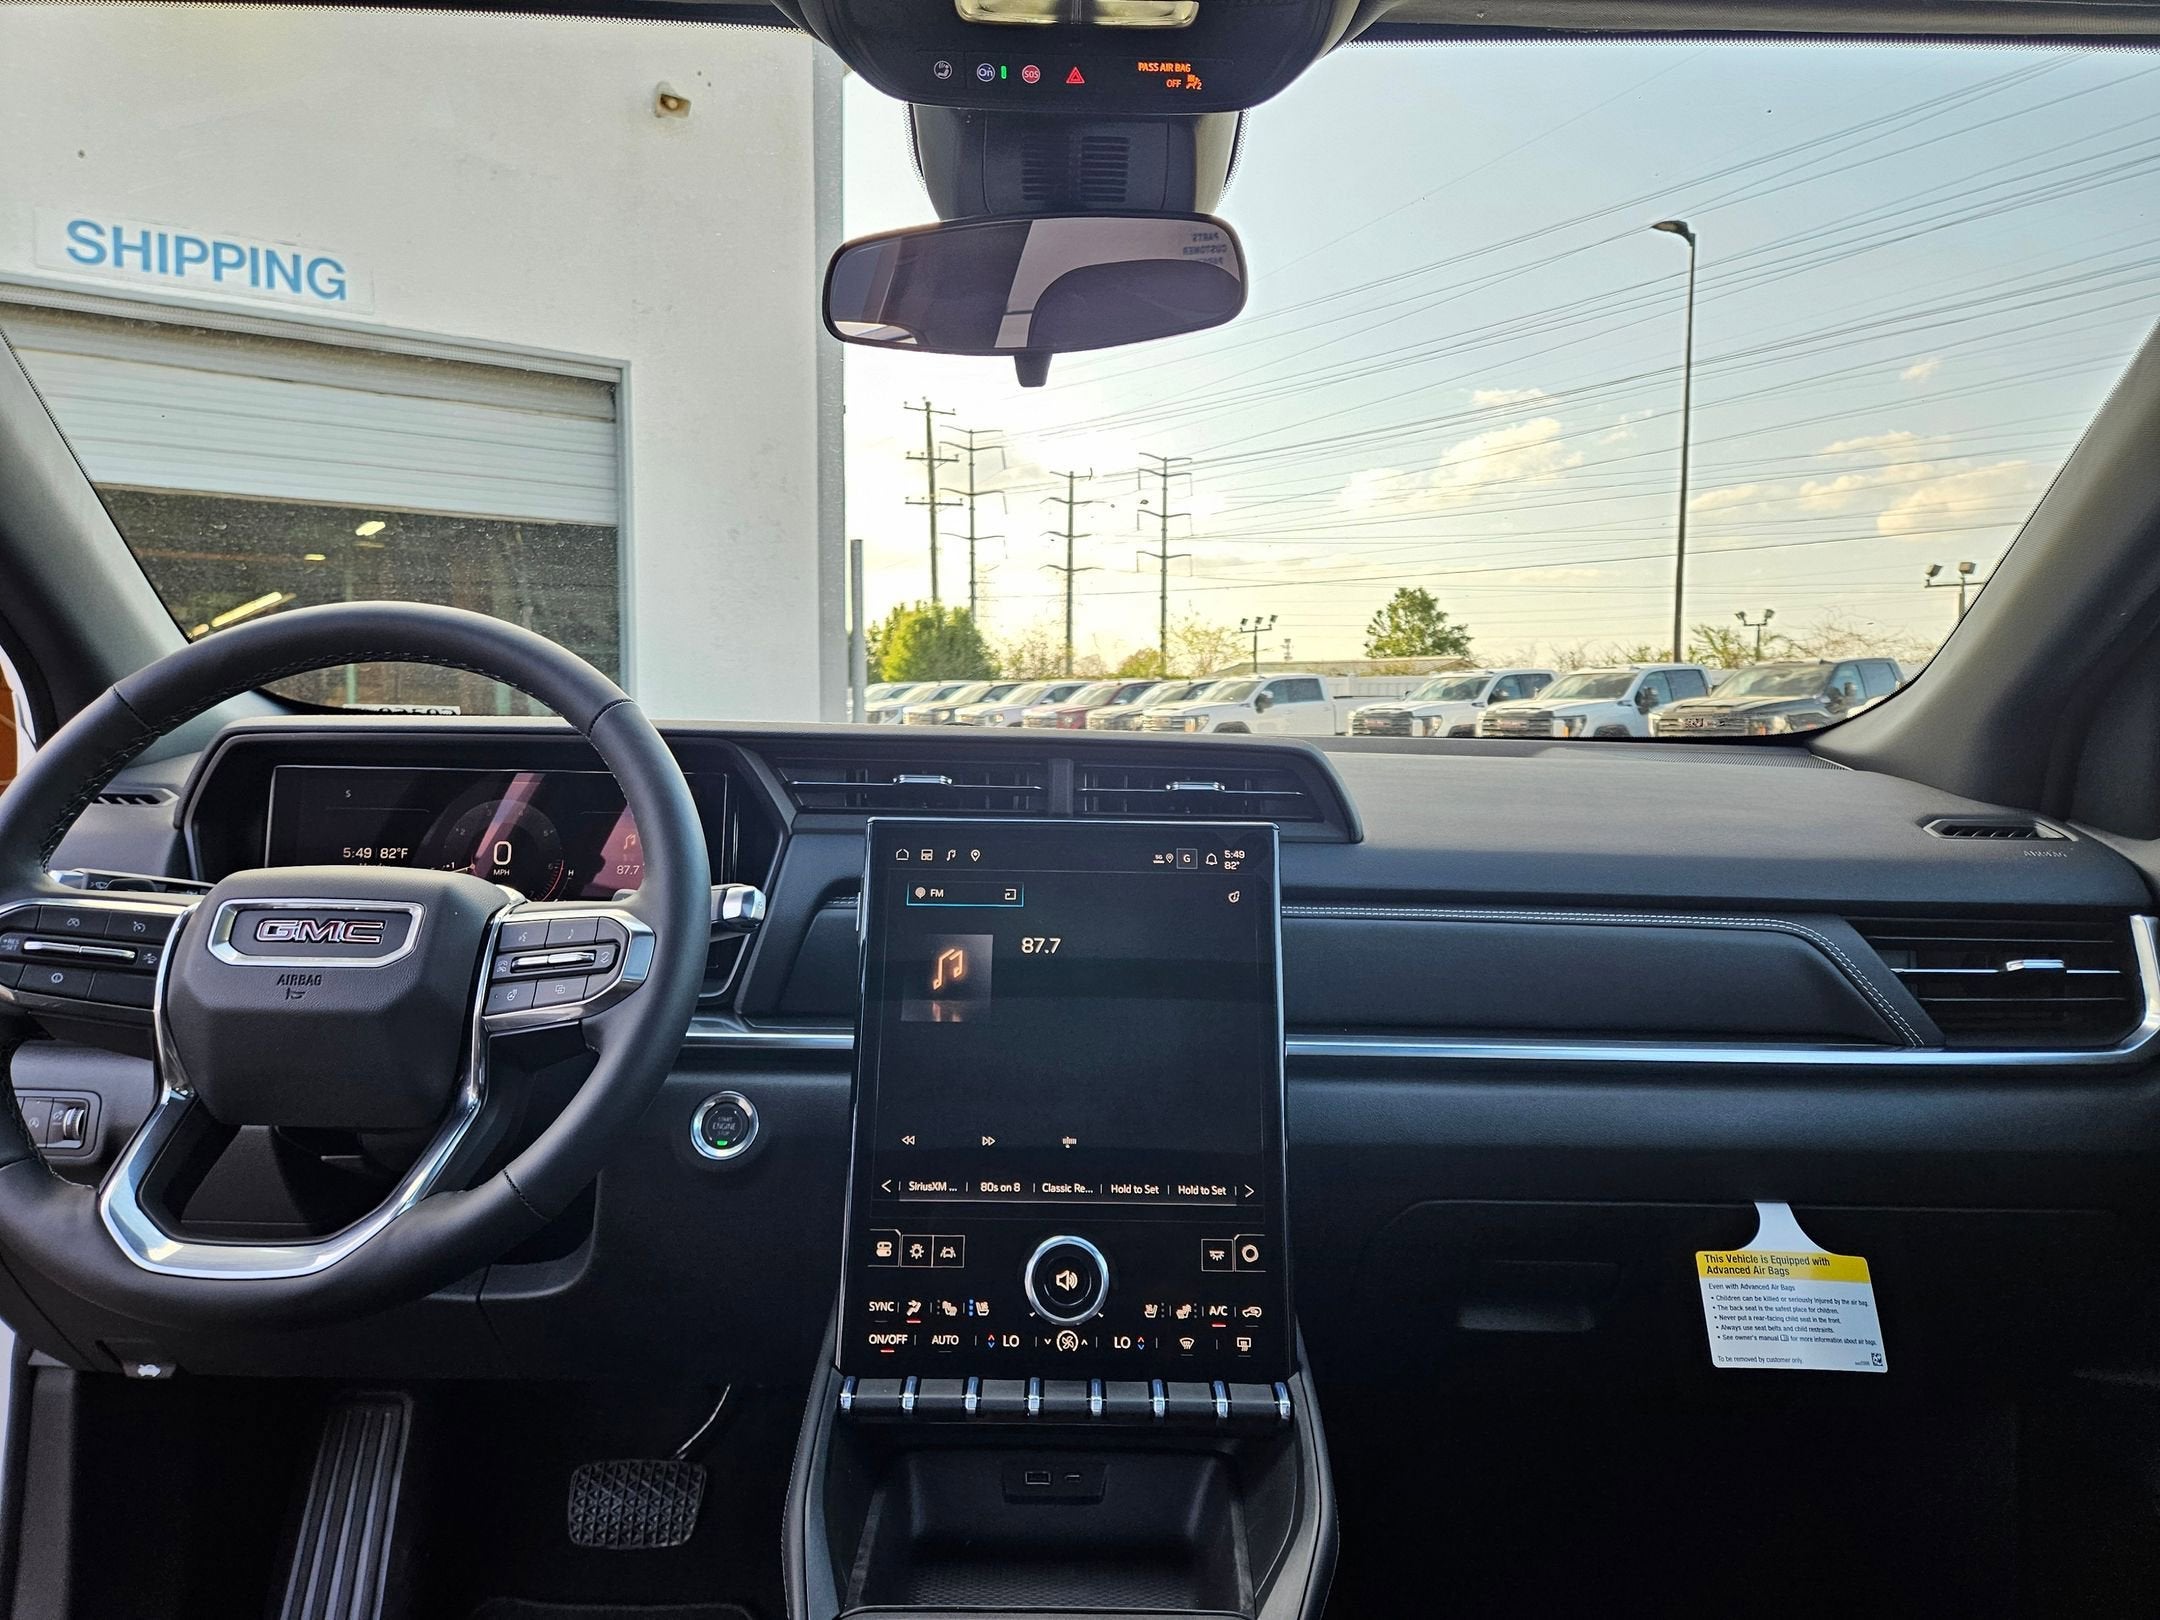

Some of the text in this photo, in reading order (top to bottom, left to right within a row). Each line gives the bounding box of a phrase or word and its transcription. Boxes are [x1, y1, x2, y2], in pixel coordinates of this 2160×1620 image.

[1137, 62, 1191, 73] PASS AIR BAG
[1024, 70, 1039, 79] SOS
[1166, 79, 1182, 88] OFF
[66, 219, 348, 301] SHIPPING
[342, 847, 409, 859] 5:49 82°F
[493, 840, 512, 866] 0
[1183, 854, 1191, 863] G
[1223, 849, 1246, 860] 5:49
[493, 869, 511, 877] MPH
[568, 869, 575, 877] H
[616, 864, 640, 875] 87.7
[929, 888, 944, 899] FM
[256, 919, 385, 944] GMC
[1021, 937, 1062, 955] 87.7
[276, 973, 323, 986] AIRBAG
[908, 1180, 947, 1192] SiriusXM
[980, 1181, 1021, 1193] 80s on 8
[1041, 1183, 1072, 1194] Classic
[1110, 1184, 1160, 1195] Hold to Set
[1178, 1185, 1227, 1196] Hold to Set
[1704, 1254, 1831, 1267] This Vehicle is Equipped with
[1706, 1265, 1790, 1277] Advanced Air Bags
[1740, 1283, 1770, 1291] Advanced
[1780, 1284, 1796, 1292] Bags
[1763, 1295, 1779, 1303] killed
[1788, 1296, 1813, 1305] seriously
[1814, 1297, 1833, 1305] injured
[1834, 1298, 1841, 1306] by
[868, 1301, 895, 1313] SYNC
[1208, 1305, 1229, 1317] A/C
[1774, 1305, 1792, 1313] safest
[1792, 1306, 1808, 1314] place
[1753, 1315, 1785, 1323] rear-facing
[1720, 1324, 1742, 1332] Always
[868, 1334, 908, 1346] ON/OFF
[931, 1334, 960, 1346] AUTO
[1002, 1335, 1020, 1348] LO
[1113, 1336, 1131, 1349] LO
[1813, 1336, 1844, 1345] information
[1758, 1356, 1765, 1364] by
